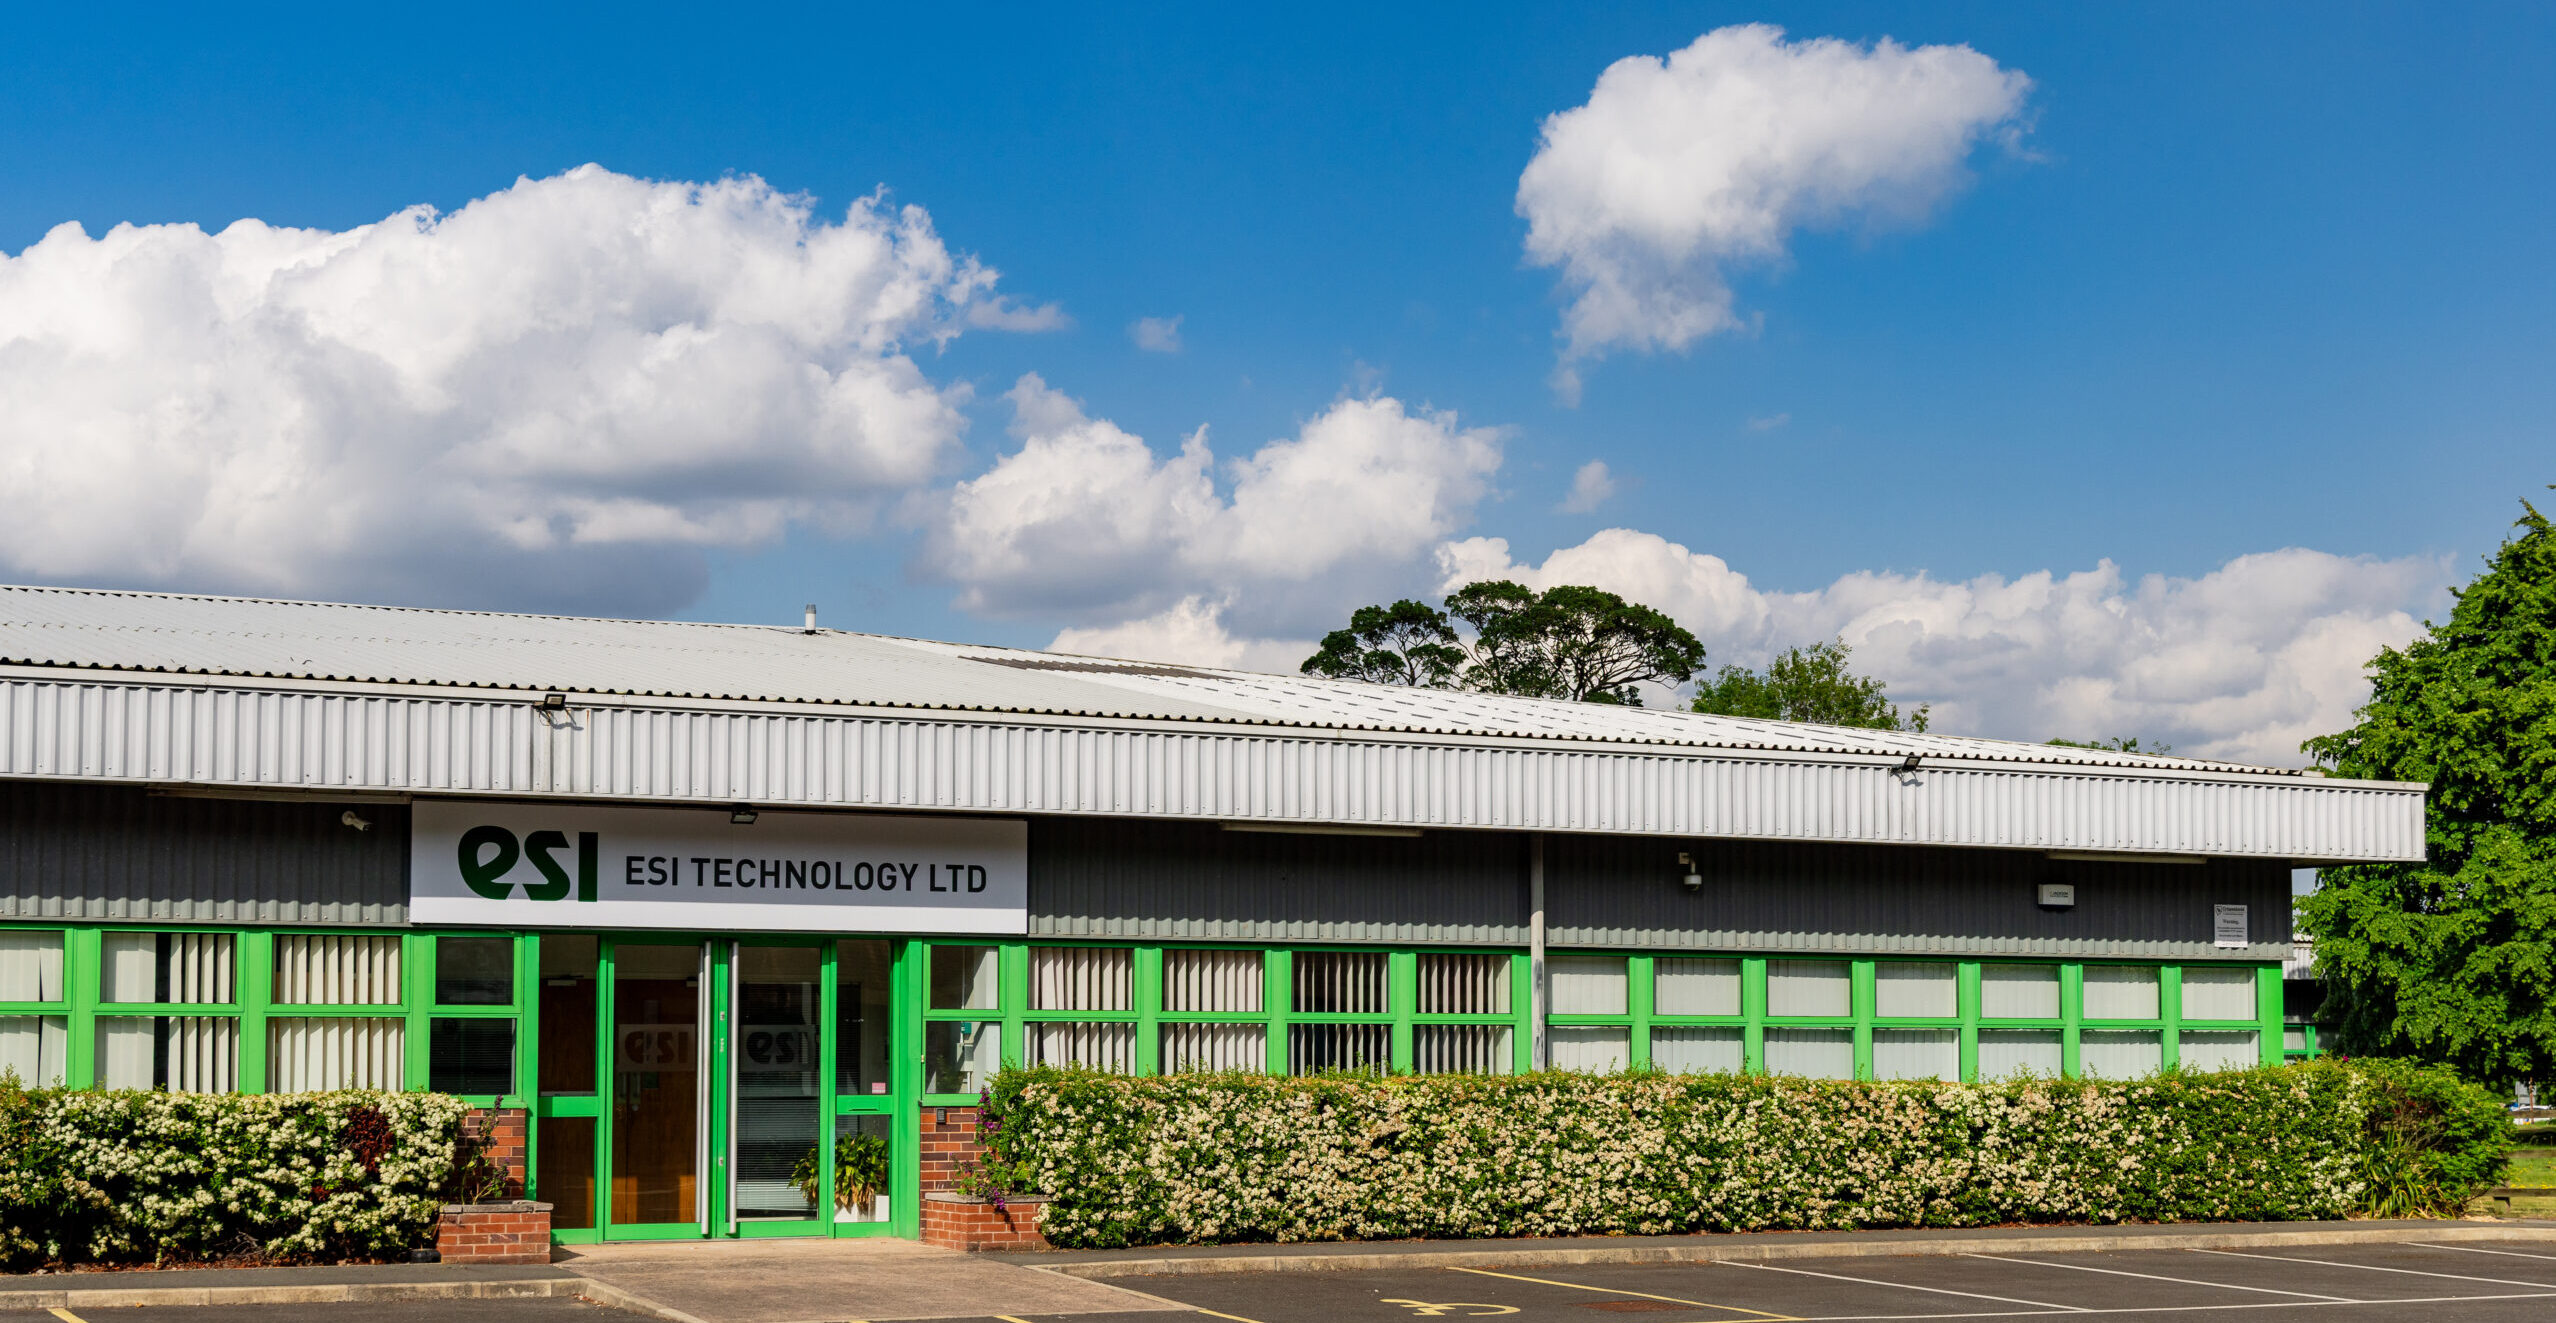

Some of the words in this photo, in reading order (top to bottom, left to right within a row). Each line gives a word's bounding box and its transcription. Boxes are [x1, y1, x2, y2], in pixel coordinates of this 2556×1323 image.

[625, 855, 679, 887] ESI
[690, 857, 920, 893] TECHNOLOGY
[929, 863, 987, 893] LTD
